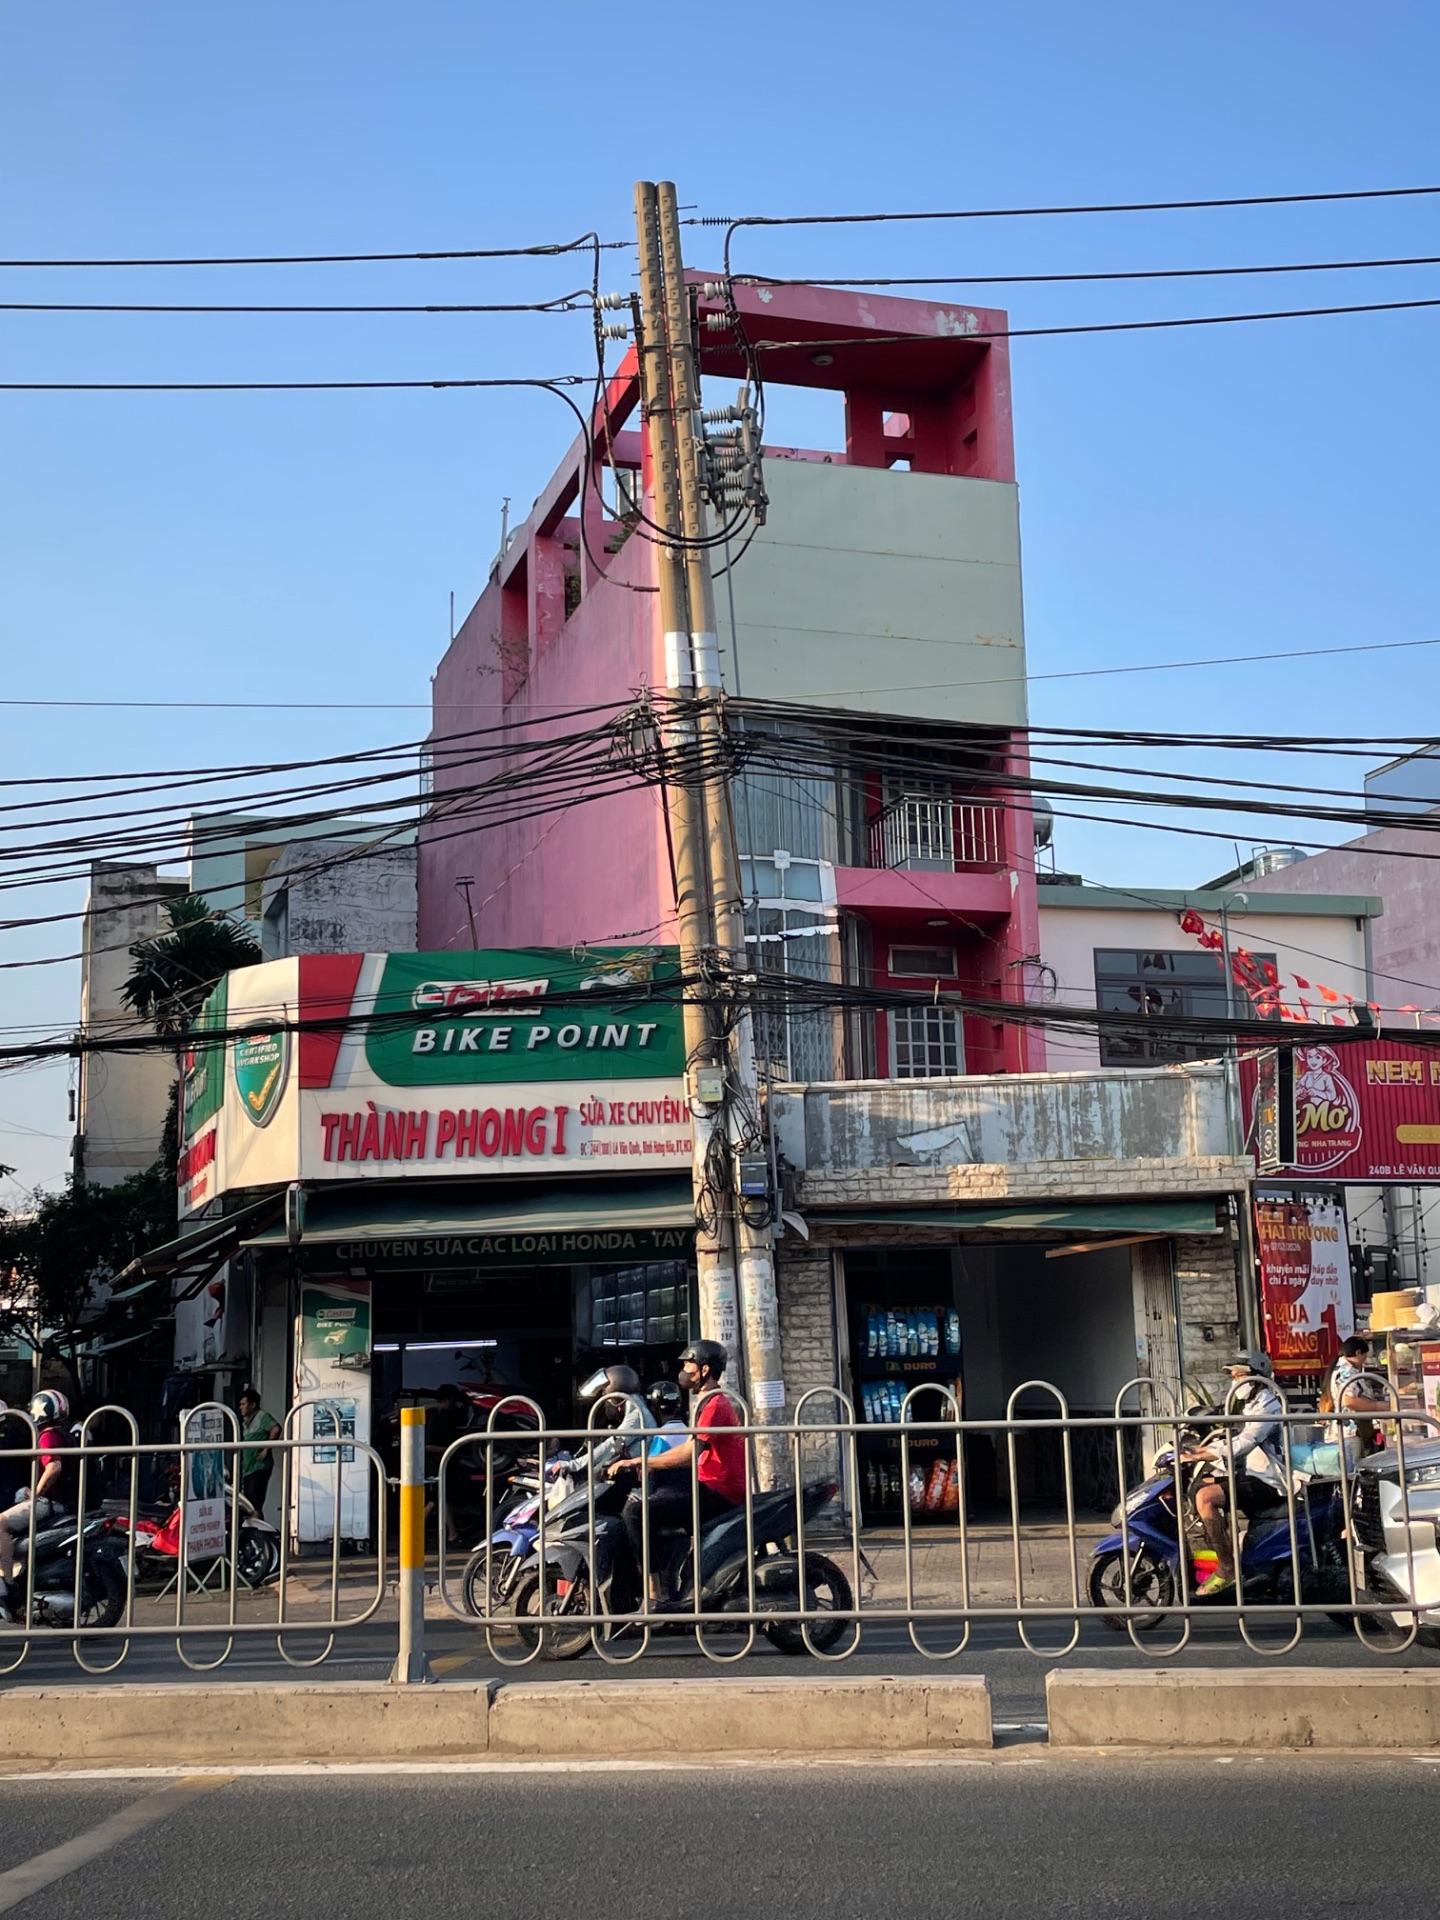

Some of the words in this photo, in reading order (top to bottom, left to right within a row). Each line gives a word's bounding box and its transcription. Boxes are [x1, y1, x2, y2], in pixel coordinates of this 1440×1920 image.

[240, 1043, 277, 1056] CERTIFIED
[413, 1027, 512, 1053] BIKE
[527, 1024, 657, 1050] POINT
[238, 1053, 280, 1066] WORKSHOP
[1366, 1060, 1425, 1085] NEM
[580, 1094, 606, 1126] SỬA
[608, 1102, 626, 1125] XE
[627, 1094, 680, 1125] CHUYÊN
[1297, 1101, 1349, 1134] Mơ
[320, 1100, 428, 1162] THÀNH
[435, 1105, 548, 1158] PHONG
[1328, 1139, 1352, 1147] TRANG
[1369, 1165, 1391, 1175] 240B
[1393, 1163, 1405, 1175] LÊ
[1407, 1163, 1426, 1175] VĂN
[511, 1236, 556, 1255] LOẠI
[562, 1233, 636, 1250] HONDA
[654, 1231, 687, 1248] TAY
[1274, 1303, 1309, 1325] MUA
[903, 1362, 937, 1371] DURO
